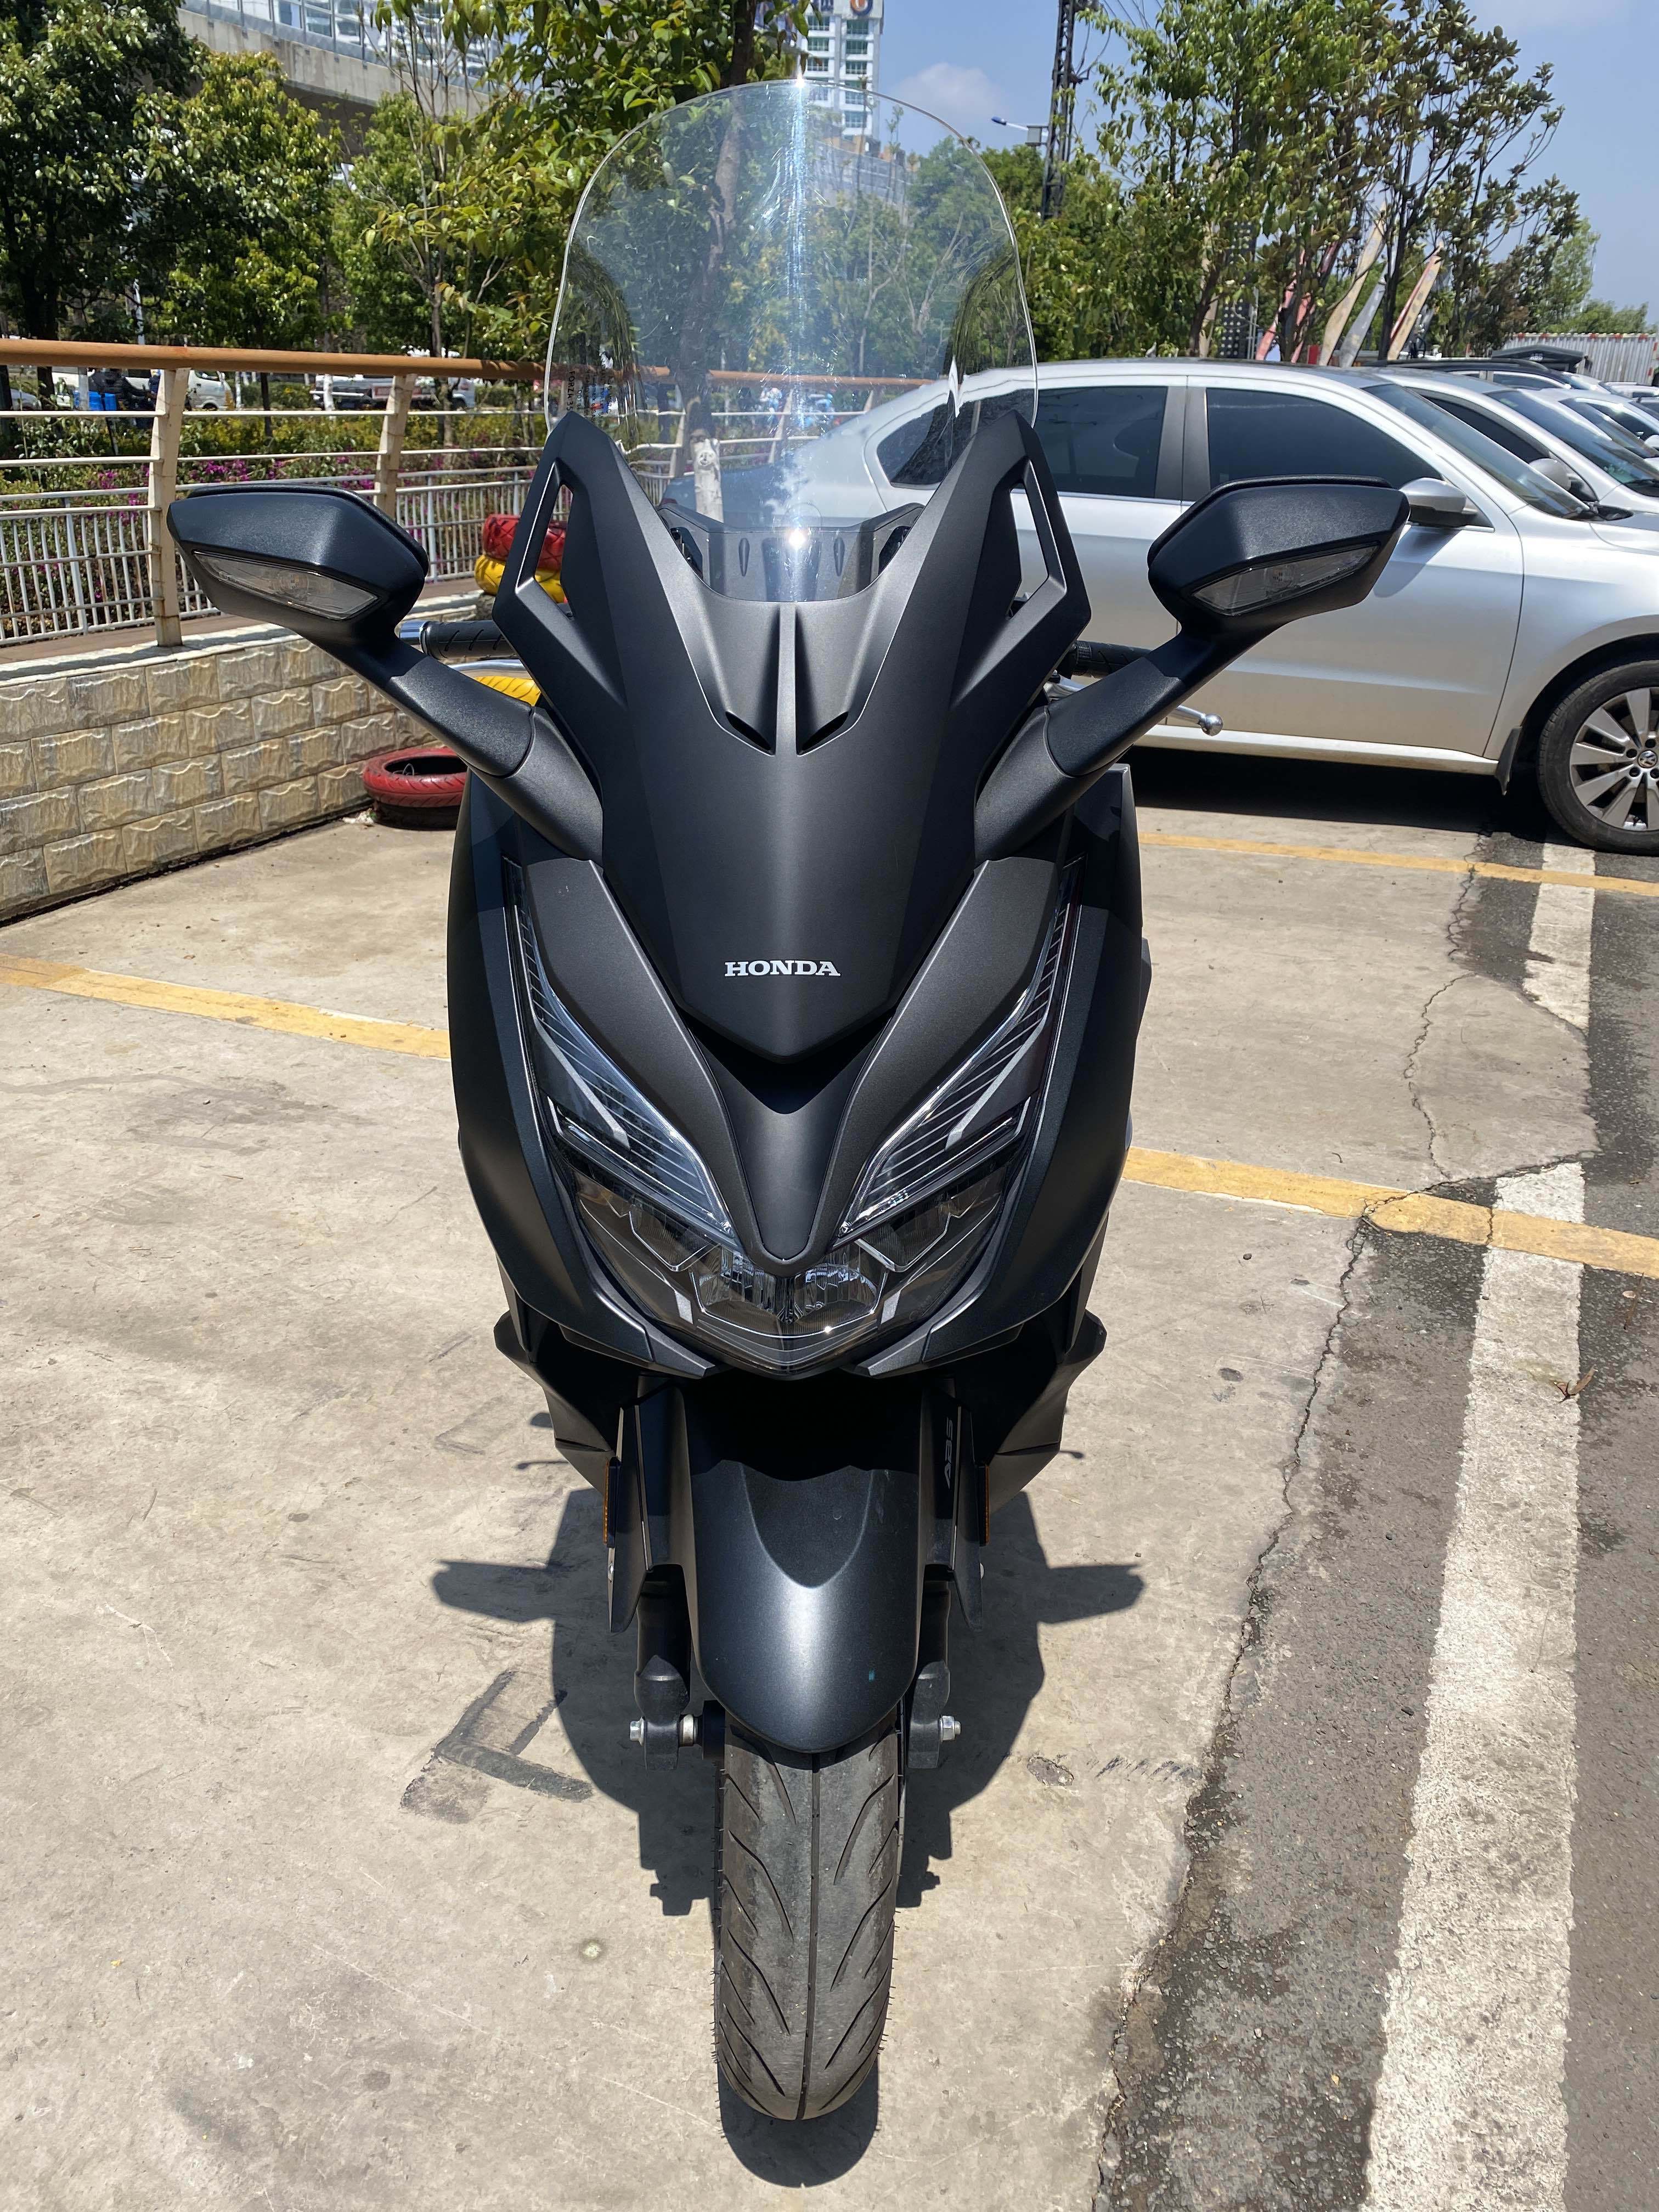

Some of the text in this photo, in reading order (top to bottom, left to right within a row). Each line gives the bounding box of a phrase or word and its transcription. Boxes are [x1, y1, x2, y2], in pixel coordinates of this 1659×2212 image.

[567, 371, 575, 399] FORZA
[724, 960, 841, 977] HONDA
[944, 1417, 953, 1489] ABS
